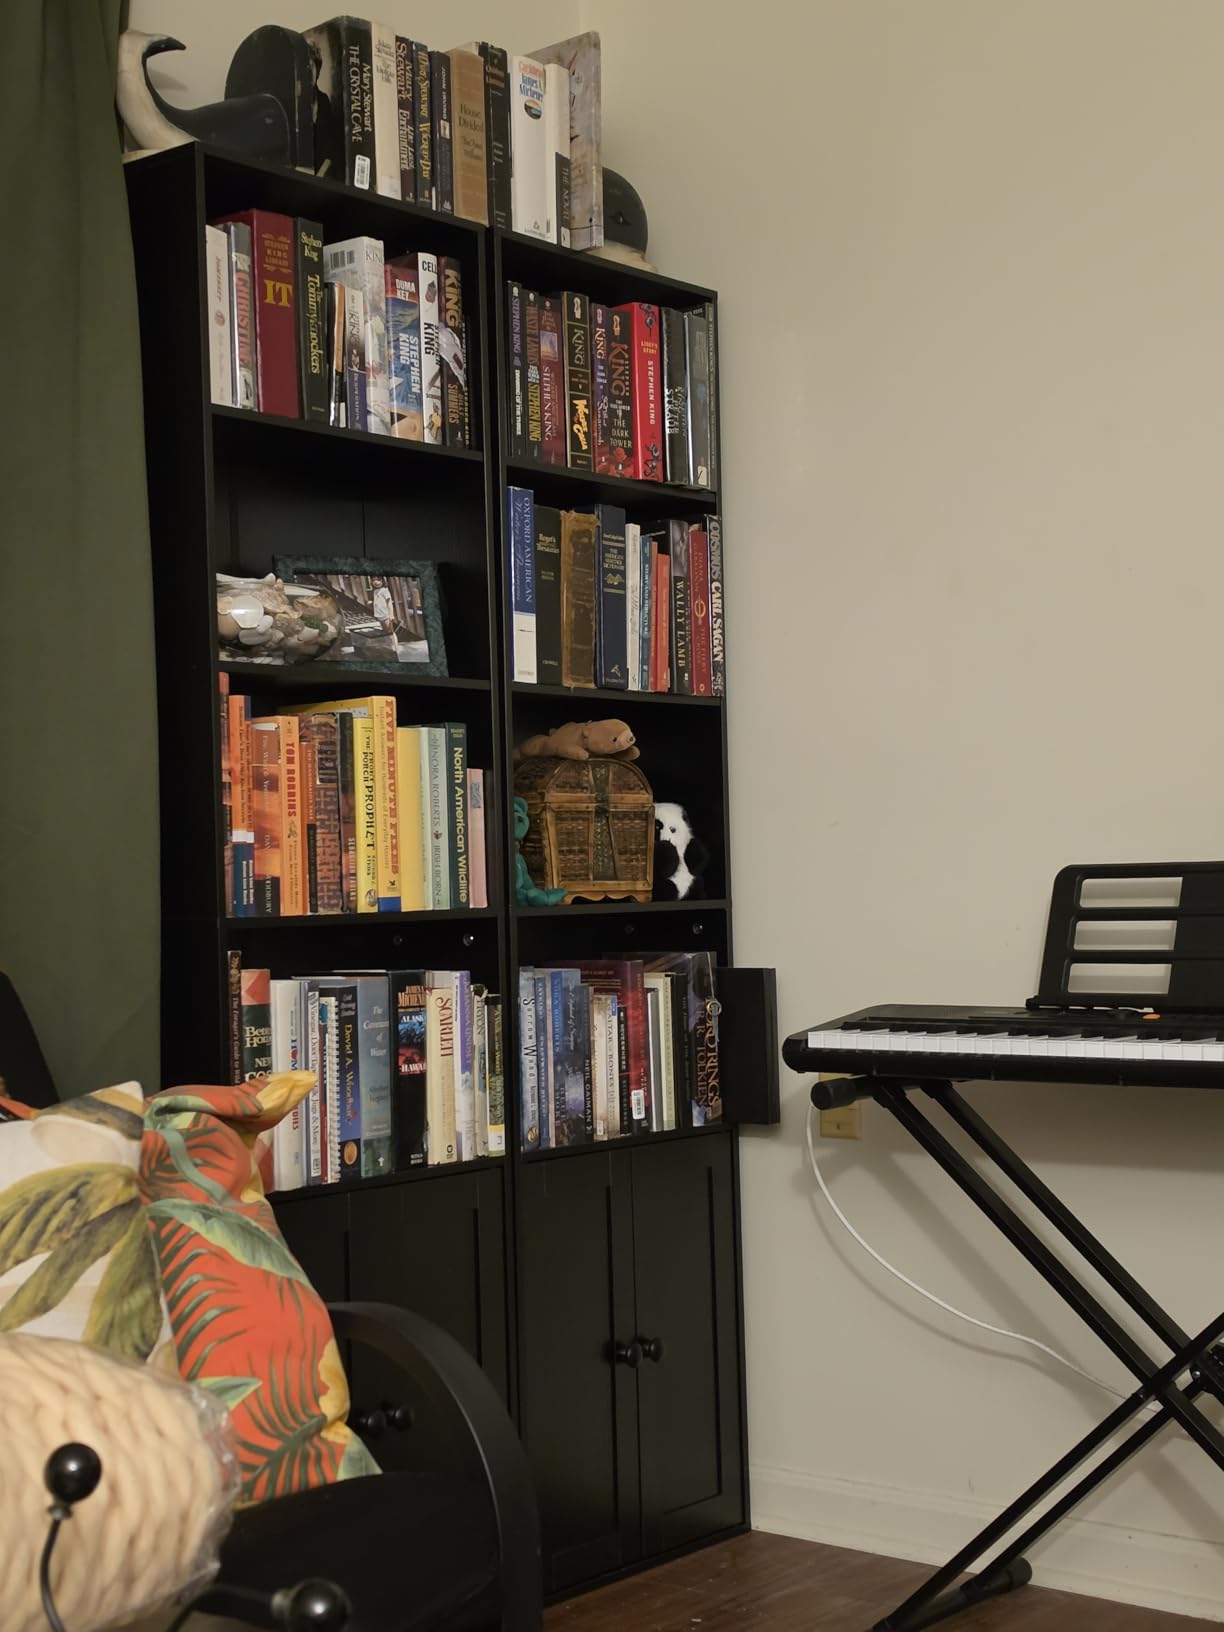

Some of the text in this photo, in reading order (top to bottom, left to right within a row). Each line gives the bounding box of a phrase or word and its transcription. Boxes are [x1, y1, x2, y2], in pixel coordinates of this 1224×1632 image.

[396, 42, 407, 101] Stewart
[404, 61, 413, 101] Mary
[348, 44, 363, 143] THE CRYSTAL CAVE
[361, 63, 373, 132] Mary Stewart
[459, 103, 481, 118] House
[399, 108, 411, 170] Enchantment
[458, 117, 484, 133] Divided
[266, 249, 288, 259] KING
[264, 279, 294, 308] IT
[395, 278, 417, 293] DUMA
[445, 268, 462, 328] KING
[306, 274, 323, 375] Tommyknockers
[423, 322, 435, 356] KING
[511, 297, 522, 354] STEPHEN KING
[594, 327, 606, 360] KING
[399, 332, 410, 365] KING
[409, 335, 421, 393] STEPHEN
[571, 328, 585, 366] KING
[607, 341, 629, 397] KING
[647, 360, 655, 401] STEPHEN
[448, 383, 460, 425] SUMMERS
[527, 382, 541, 420] STEPHEN
[542, 365, 553, 441] STEPHEN KING
[665, 387, 675, 435] STRAUB
[529, 419, 542, 442] KING
[609, 436, 633, 449] TOWER
[611, 427, 630, 438] DARK
[612, 418, 626, 428] THE
[522, 497, 533, 602] OXFORD AMERICAN
[711, 580, 723, 617] CARL
[675, 580, 686, 668] WALLY LAMB
[712, 617, 724, 663] SAGAN
[286, 742, 297, 817] TOM ROBBINS
[362, 751, 371, 783] PORCH
[431, 750, 441, 828] NORA ROBERTS
[364, 784, 376, 850] PROPHET
[453, 746, 468, 903] North American Wildlife
[433, 844, 442, 897] IRISH BORN
[372, 1005, 384, 1015] The
[435, 995, 455, 1058] SCARLETT
[233, 1041, 241, 1060] Guide
[344, 1024, 353, 1054] David
[522, 998, 537, 1078] Sorrow Wood
[344, 1057, 353, 1069] A.
[697, 1046, 707, 1106] TOLKIEN
[705, 1052, 720, 1106] RINGS
[312, 1125, 320, 1145] More
